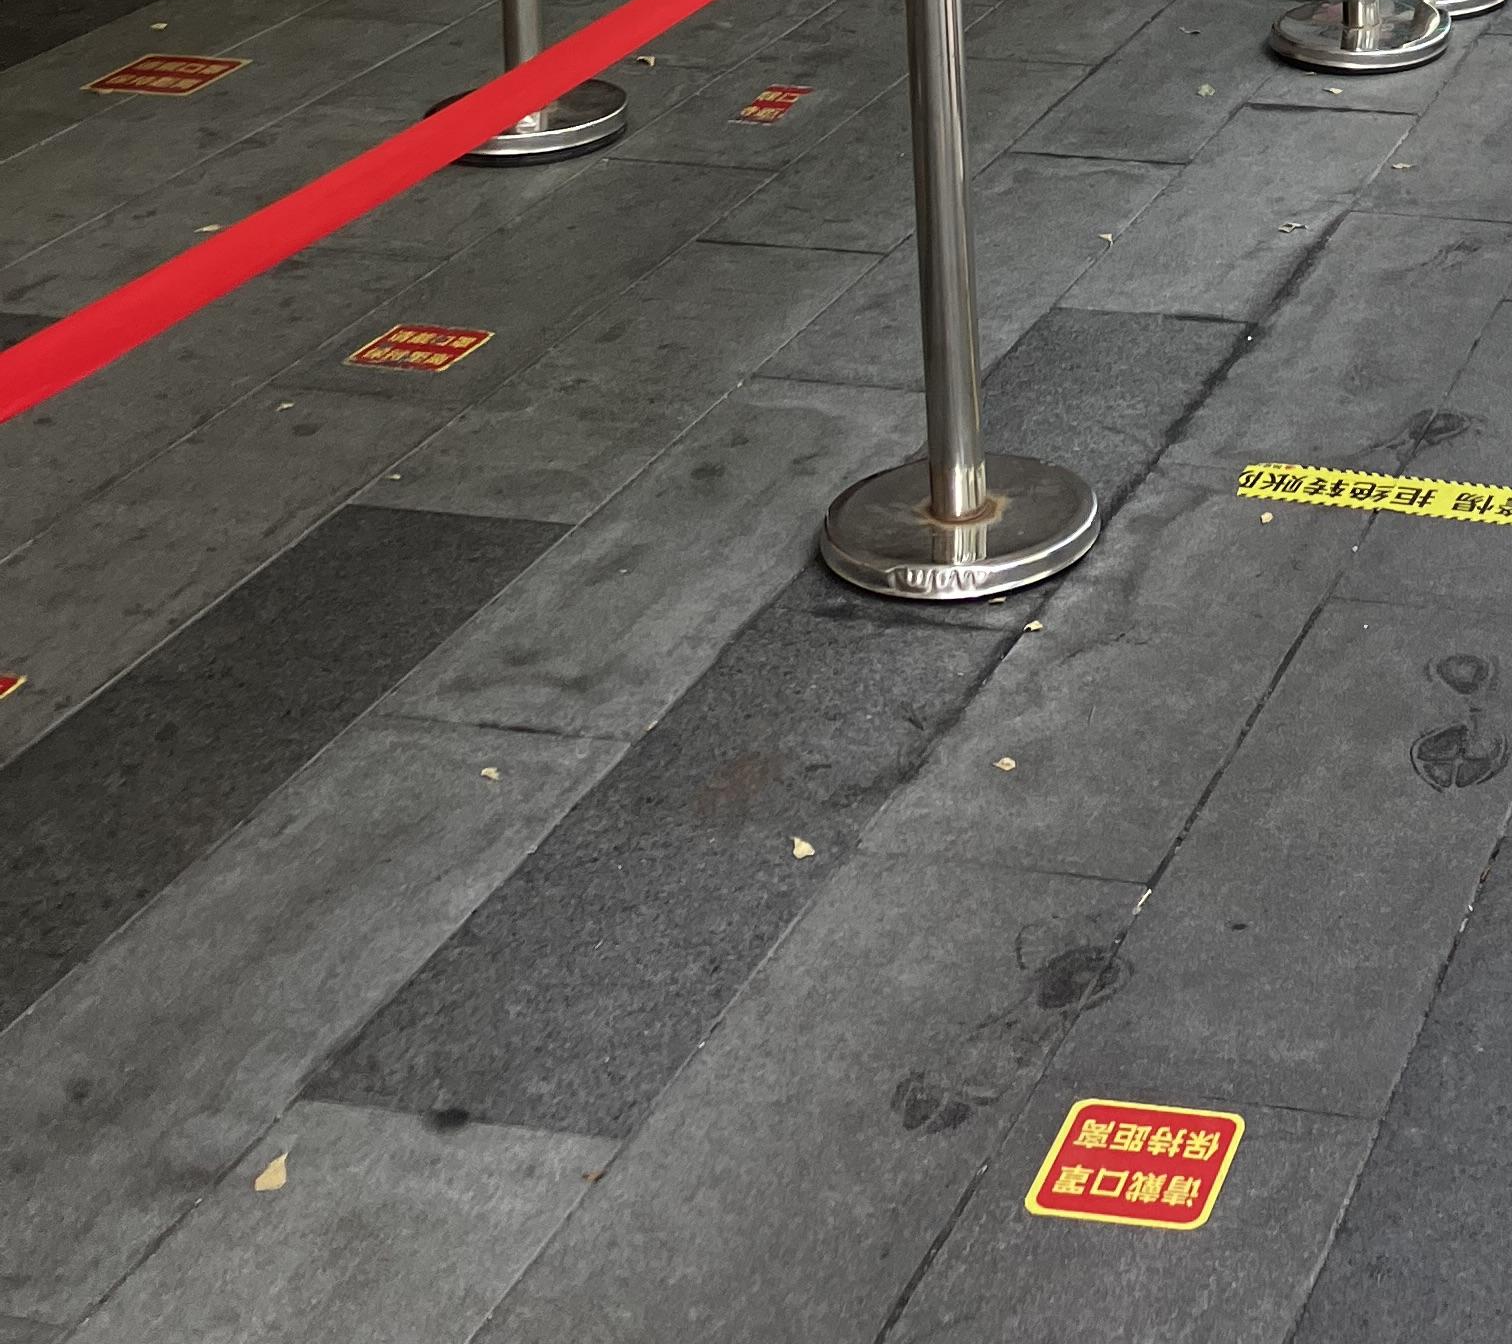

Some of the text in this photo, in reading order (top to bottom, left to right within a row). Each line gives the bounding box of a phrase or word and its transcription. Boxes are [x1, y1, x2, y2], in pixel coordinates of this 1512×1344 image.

[1073, 1118, 1221, 1161] 保持距离
[1052, 1164, 1202, 1207] 请戴口罩
